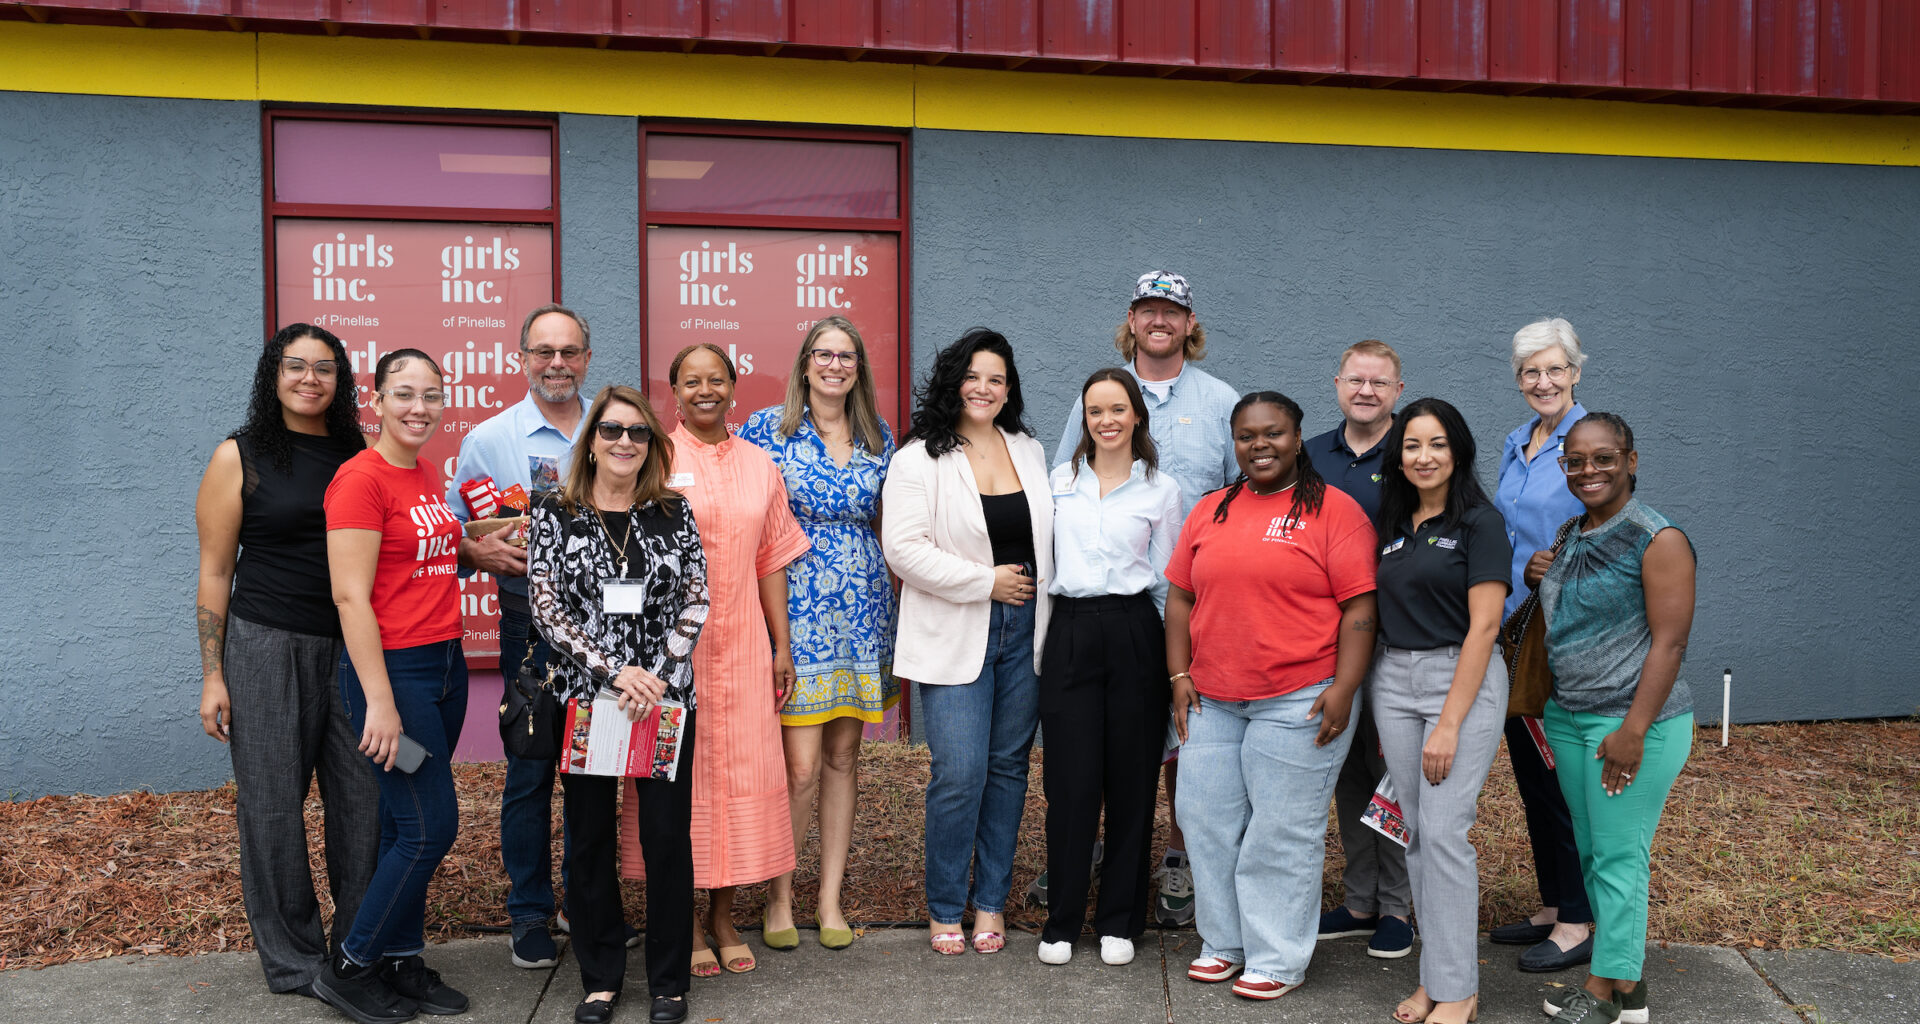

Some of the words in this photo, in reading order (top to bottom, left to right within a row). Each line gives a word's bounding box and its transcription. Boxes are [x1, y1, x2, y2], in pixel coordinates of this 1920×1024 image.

[312, 232, 394, 277] girls
[441, 235, 520, 279] girls
[679, 241, 754, 281] girls
[796, 243, 869, 284] girls
[312, 267, 376, 302] inc.
[441, 269, 502, 304] inc.
[679, 274, 737, 306] inc.
[796, 276, 852, 309] inc.
[314, 315, 327, 326] of
[330, 314, 380, 327] Pinellas
[442, 316, 455, 328] of
[458, 316, 506, 328] Pinellas
[680, 319, 692, 330] of
[694, 318, 740, 331] Pinellas
[796, 320, 809, 332] of
[442, 340, 521, 384] girls
[443, 374, 504, 409] inc.
[443, 421, 457, 433] of
[409, 494, 459, 537] girls
[416, 528, 456, 562] inc.
[412, 567, 424, 579] OF
[463, 628, 501, 641] Pinella
